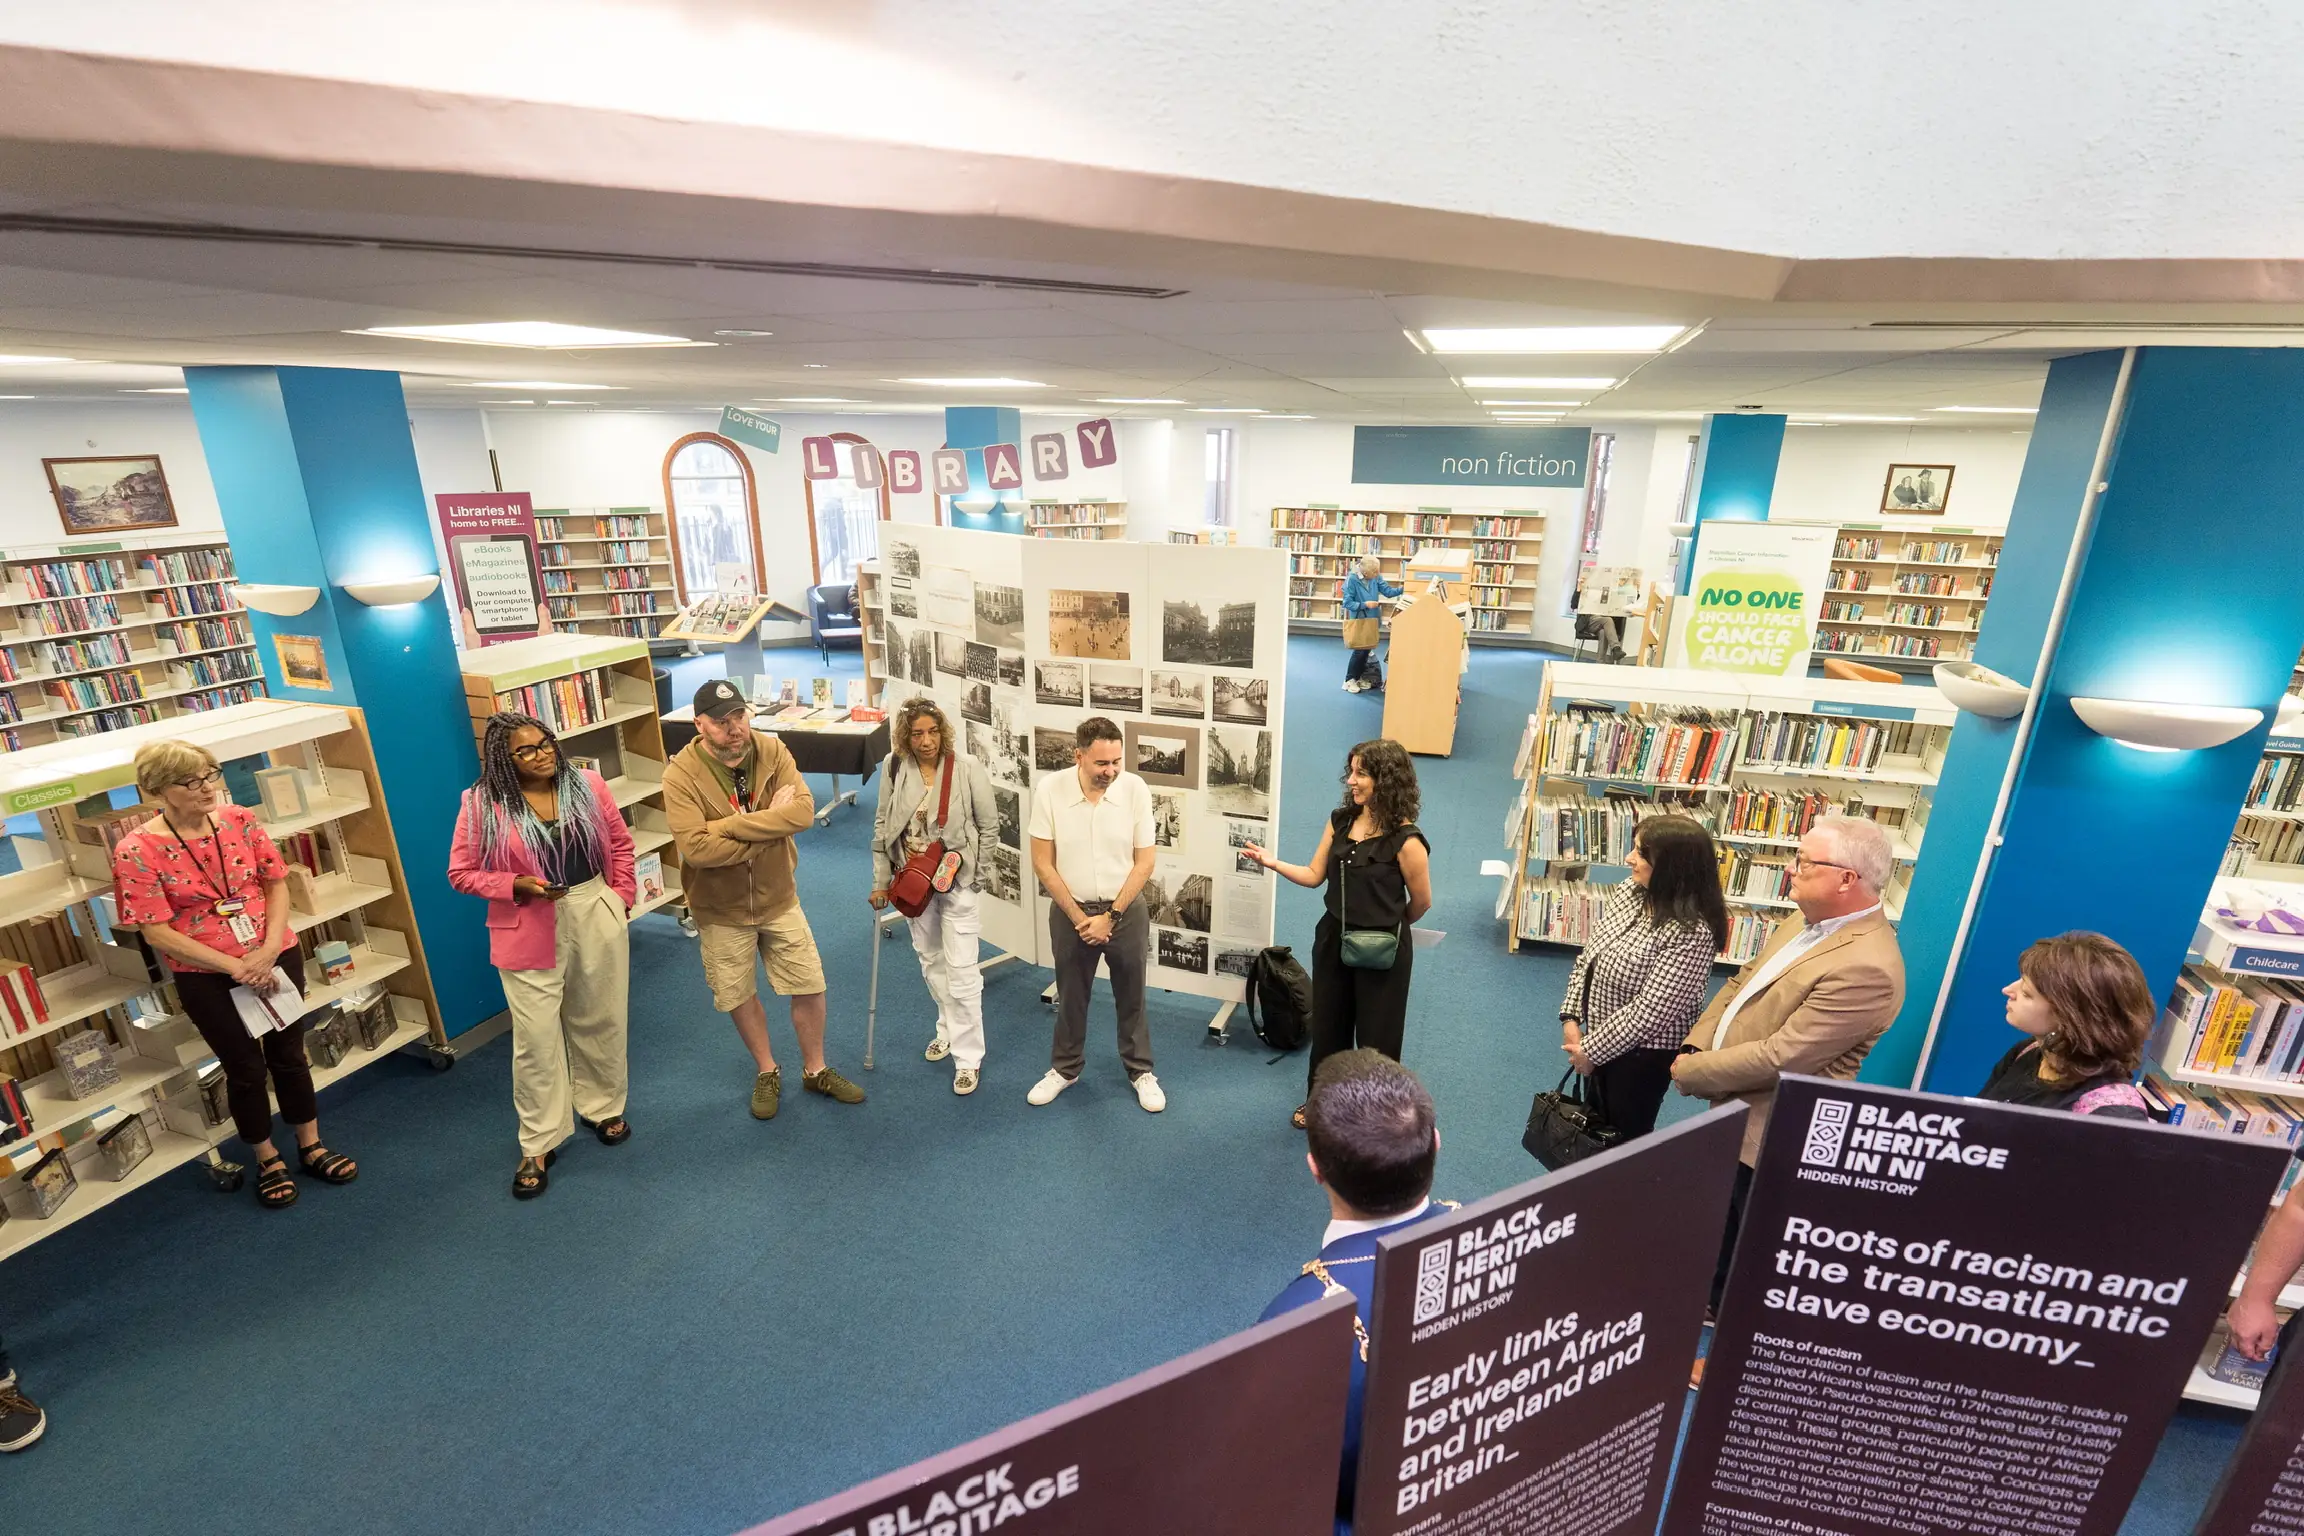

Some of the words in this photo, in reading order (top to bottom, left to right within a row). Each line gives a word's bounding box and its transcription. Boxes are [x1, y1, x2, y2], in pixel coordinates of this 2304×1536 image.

[728, 409, 754, 428] LOVE
[755, 420, 777, 436] YOUR
[813, 425, 1107, 488] LIBRARY
[1442, 456, 1488, 474] non
[1497, 452, 1576, 476] fiction
[450, 506, 504, 517] Libraries
[508, 505, 521, 515] NI
[450, 520, 477, 528] home
[492, 519, 525, 527] FREE...
[466, 559, 525, 569] eMagazines
[474, 545, 511, 553] eBooks
[469, 572, 527, 582] audiobooks
[1701, 588, 1742, 606] NO
[1747, 590, 1803, 609] ONE
[482, 606, 528, 614] smartphone
[1696, 611, 1759, 624] SHOULD
[1763, 613, 1801, 627] FACE
[1696, 626, 1792, 646] CANCER
[1700, 645, 1785, 667] ALONE
[2279, 740, 2301, 748] Guides
[16, 787, 72, 807] Classics
[2246, 956, 2299, 970] Childcare
[1857, 1104, 1965, 1139] BLACK
[1844, 1151, 1881, 1174] IN
[1888, 1158, 1926, 1181] NI
[1850, 1127, 2009, 1170] HERITAGE
[1797, 1168, 1851, 1187] HIDDEN
[1854, 1176, 1918, 1196] HISTORY
[1454, 1213, 1577, 1283] HERITAGE
[1457, 1203, 1544, 1257] BLACK
[1782, 1216, 1898, 1260] Roots
[1903, 1239, 1950, 1267] of
[1948, 1253, 2094, 1291] racism
[2097, 1276, 2188, 1306] and
[1451, 1277, 1481, 1309] IN
[1488, 1262, 1518, 1294] NI
[1774, 1248, 1849, 1284] the
[1863, 1264, 2170, 1339] transatlantic
[1411, 1313, 1459, 1344] HIDDEN
[1462, 1291, 1513, 1323] HISTORY
[1763, 1285, 1870, 1325] slave
[1877, 1311, 2095, 1368] economy_
[1407, 1350, 1497, 1410] Early
[1502, 1311, 1579, 1366] links
[1753, 1333, 1794, 1347] Roots
[1796, 1341, 1811, 1351] of
[1813, 1344, 1862, 1360] racism
[1402, 1357, 1551, 1448] between
[1556, 1311, 1643, 1372] Africa
[1750, 1346, 1776, 1358] The
[1778, 1351, 1853, 1372] foundation
[1856, 1365, 1870, 1376] of
[1873, 1370, 1919, 1385] racism
[1923, 1378, 1951, 1390] and
[1954, 1383, 1978, 1395] the
[1981, 1389, 2069, 1412] transatlantic
[2071, 1405, 2111, 1420] trade
[2113, 1413, 2128, 1422] in
[2224, 1368, 2238, 1377] WE
[2240, 1373, 2262, 1382] CAN
[1398, 1424, 1466, 1481] and
[1474, 1365, 1585, 1445] Ireland
[1588, 1333, 1646, 1386] and
[1742, 1373, 1770, 1384] race
[1773, 1378, 1819, 1395] theory.
[1822, 1387, 1937, 1416] Pseudo-scientific
[1939, 1409, 1978, 1423] ideas
[1979, 1418, 2015, 1431] were
[2017, 1424, 2054, 1438] used
[2057, 1431, 2072, 1441] to
[2072, 1434, 2117, 1452] justify
[1745, 1359, 1806, 1377] enslaved
[1808, 1370, 1863, 1388] Africans
[1865, 1383, 1892, 1394] was
[1894, 1386, 1941, 1403] rooted
[1943, 1395, 1956, 1405] in
[1958, 1398, 2049, 1424] 17th-century
[2049, 1415, 2122, 1438] European
[1734, 1397, 1748, 1407] of
[1751, 1400, 1798, 1416] certain
[1801, 1409, 1838, 1424] racial
[1897, 1429, 1976, 1452] particularly
[1978, 1444, 2030, 1463] people
[2033, 1453, 2049, 1464] of
[2052, 1458, 2104, 1475] African
[1738, 1384, 1826, 1409] discrimination
[1828, 1401, 1853, 1414] and
[1855, 1407, 1911, 1425] promote
[1912, 1417, 1950, 1432] ideas
[1949, 1424, 1965, 1435] of
[1964, 1427, 1988, 1439] the
[1989, 1432, 2046, 1450] inherent
[2045, 1443, 2111, 1465] inferiority
[1458, 1495, 1495, 1523] Empire
[1497, 1469, 1542, 1501] spanned
[1544, 1466, 1549, 1475] a
[1552, 1450, 1575, 1471] wide
[1577, 1440, 1597, 1456] area
[1600, 1427, 1617, 1444] and
[1619, 1417, 1638, 1433] was
[1639, 1401, 1665, 1422] made
[1728, 1420, 1751, 1432] the
[1753, 1426, 1843, 1451] enslavement
[1847, 1445, 1861, 1455] of
[1865, 1449, 1920, 1466] millions
[1923, 1460, 1938, 1470] of
[1941, 1464, 1996, 1483] people.
[1999, 1475, 2074, 1498] Concepts
[2076, 1490, 2093, 1500] of
[1731, 1408, 1790, 1426] descent.
[1794, 1420, 1838, 1437] These
[1842, 1431, 1899, 1449] theories
[1902, 1443, 2003, 1469] dehumanised
[2006, 1463, 2036, 1476] and
[2038, 1469, 2099, 1489] justified
[867, 1462, 1014, 1536] BLACK
[1396, 1443, 1520, 1516] Britain_
[1705, 1502, 1772, 1523] Formation
[1775, 1517, 1789, 1526] of
[1791, 1521, 1813, 1532] the
